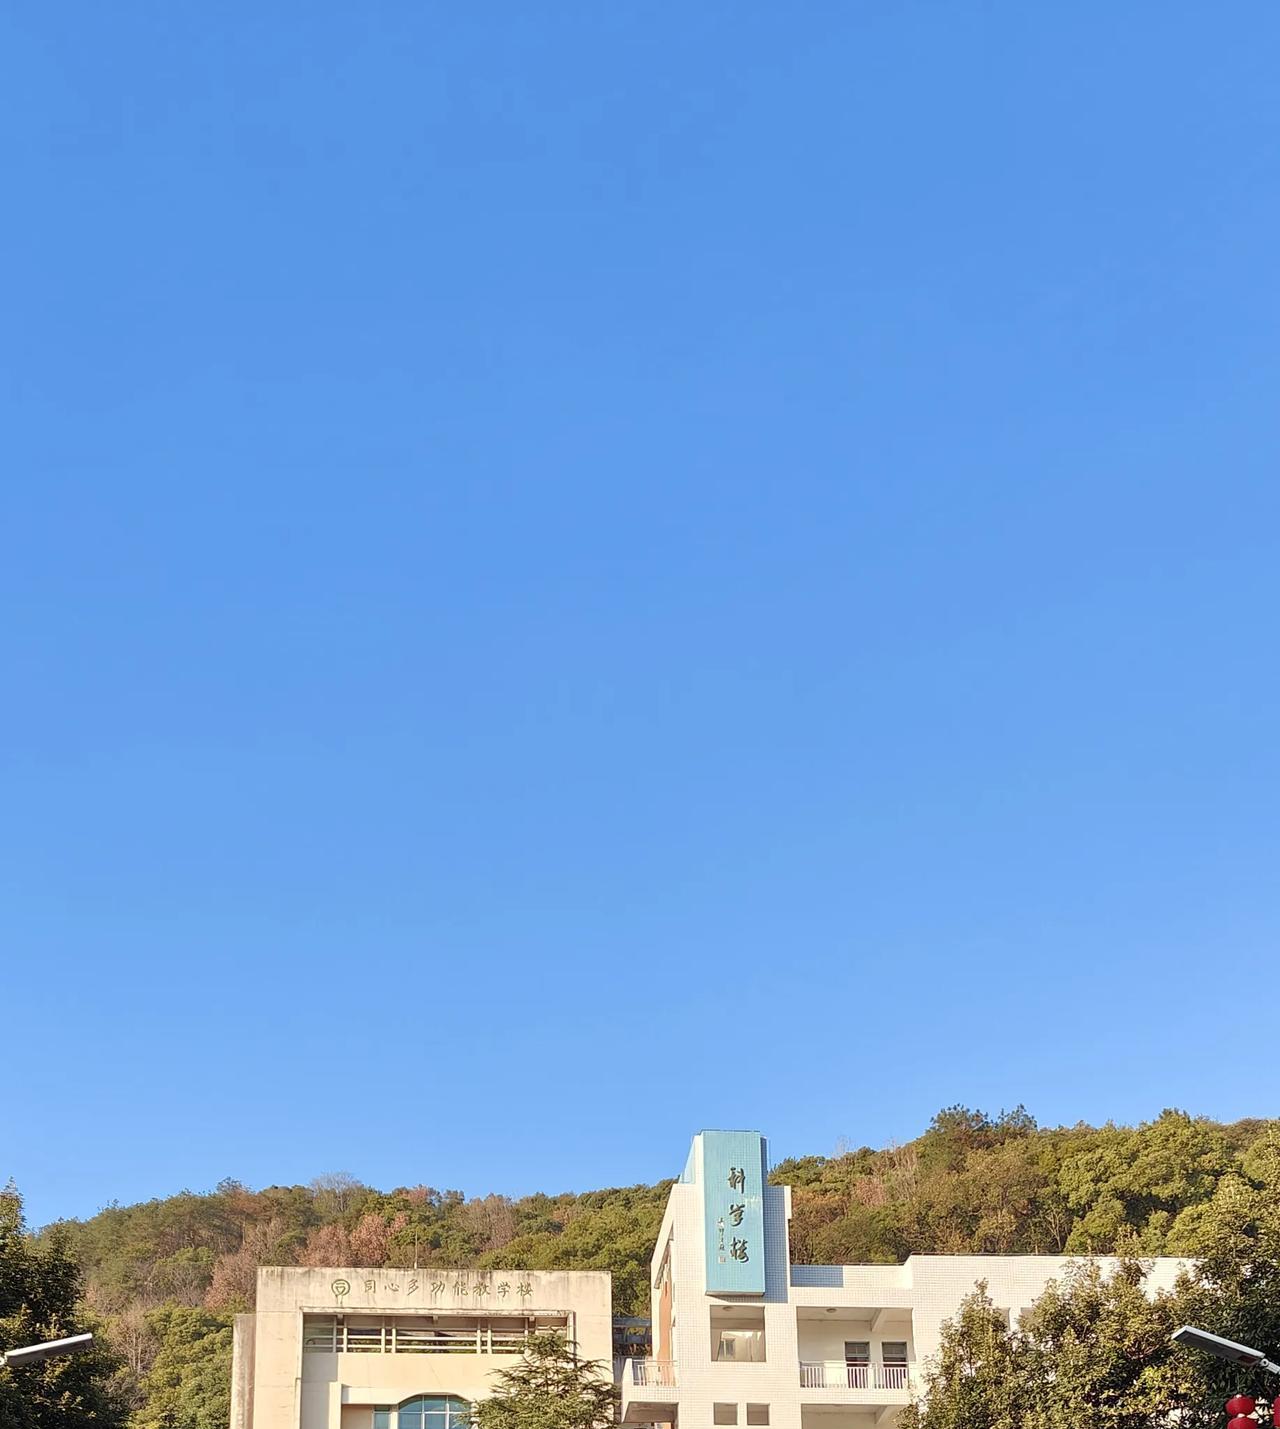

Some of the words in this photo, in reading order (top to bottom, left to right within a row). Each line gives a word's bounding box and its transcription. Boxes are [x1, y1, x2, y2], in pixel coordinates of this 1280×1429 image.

[363, 1279, 535, 1297] 同心多功能教学楼
